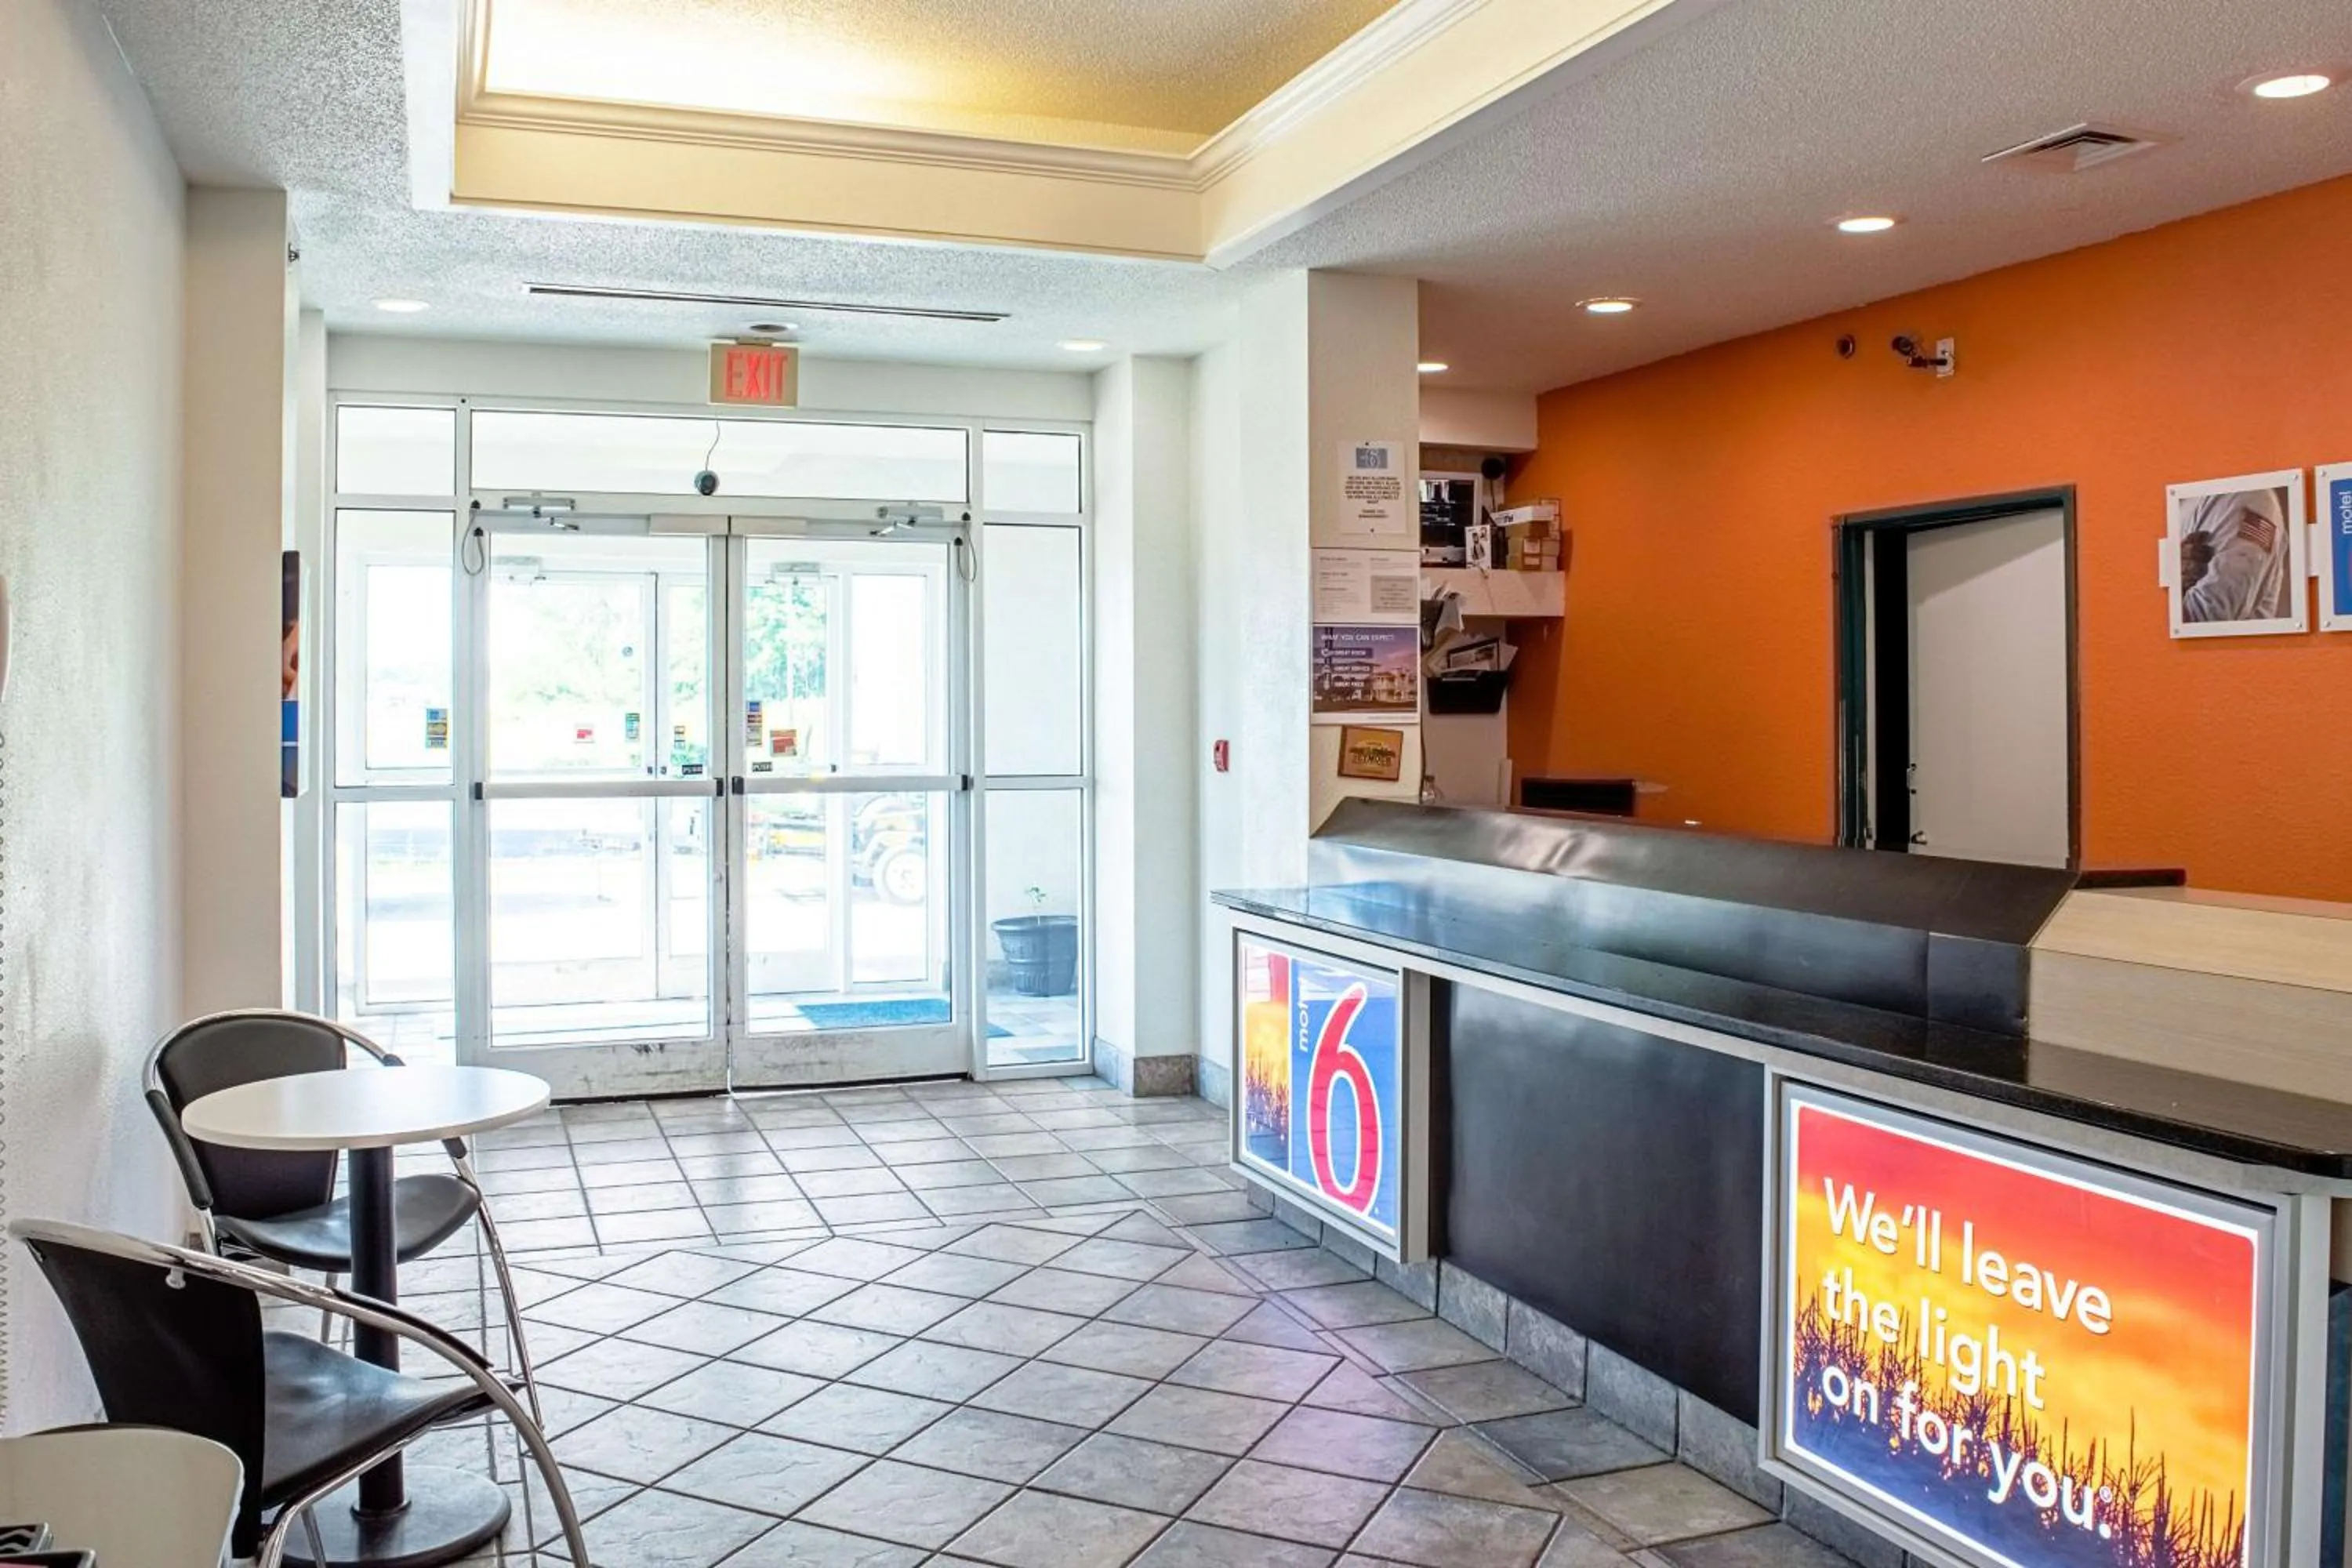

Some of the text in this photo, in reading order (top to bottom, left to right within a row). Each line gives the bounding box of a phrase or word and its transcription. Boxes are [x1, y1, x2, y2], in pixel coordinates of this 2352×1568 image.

[726, 350, 788, 402] EXIT
[2339, 490, 2352, 534] motel
[1307, 982, 1382, 1217] 6
[1824, 1178, 2113, 1334] We'll leave
[1823, 1267, 2045, 1410] the light
[1822, 1365, 1877, 1425] on
[1896, 1380, 1973, 1466] for
